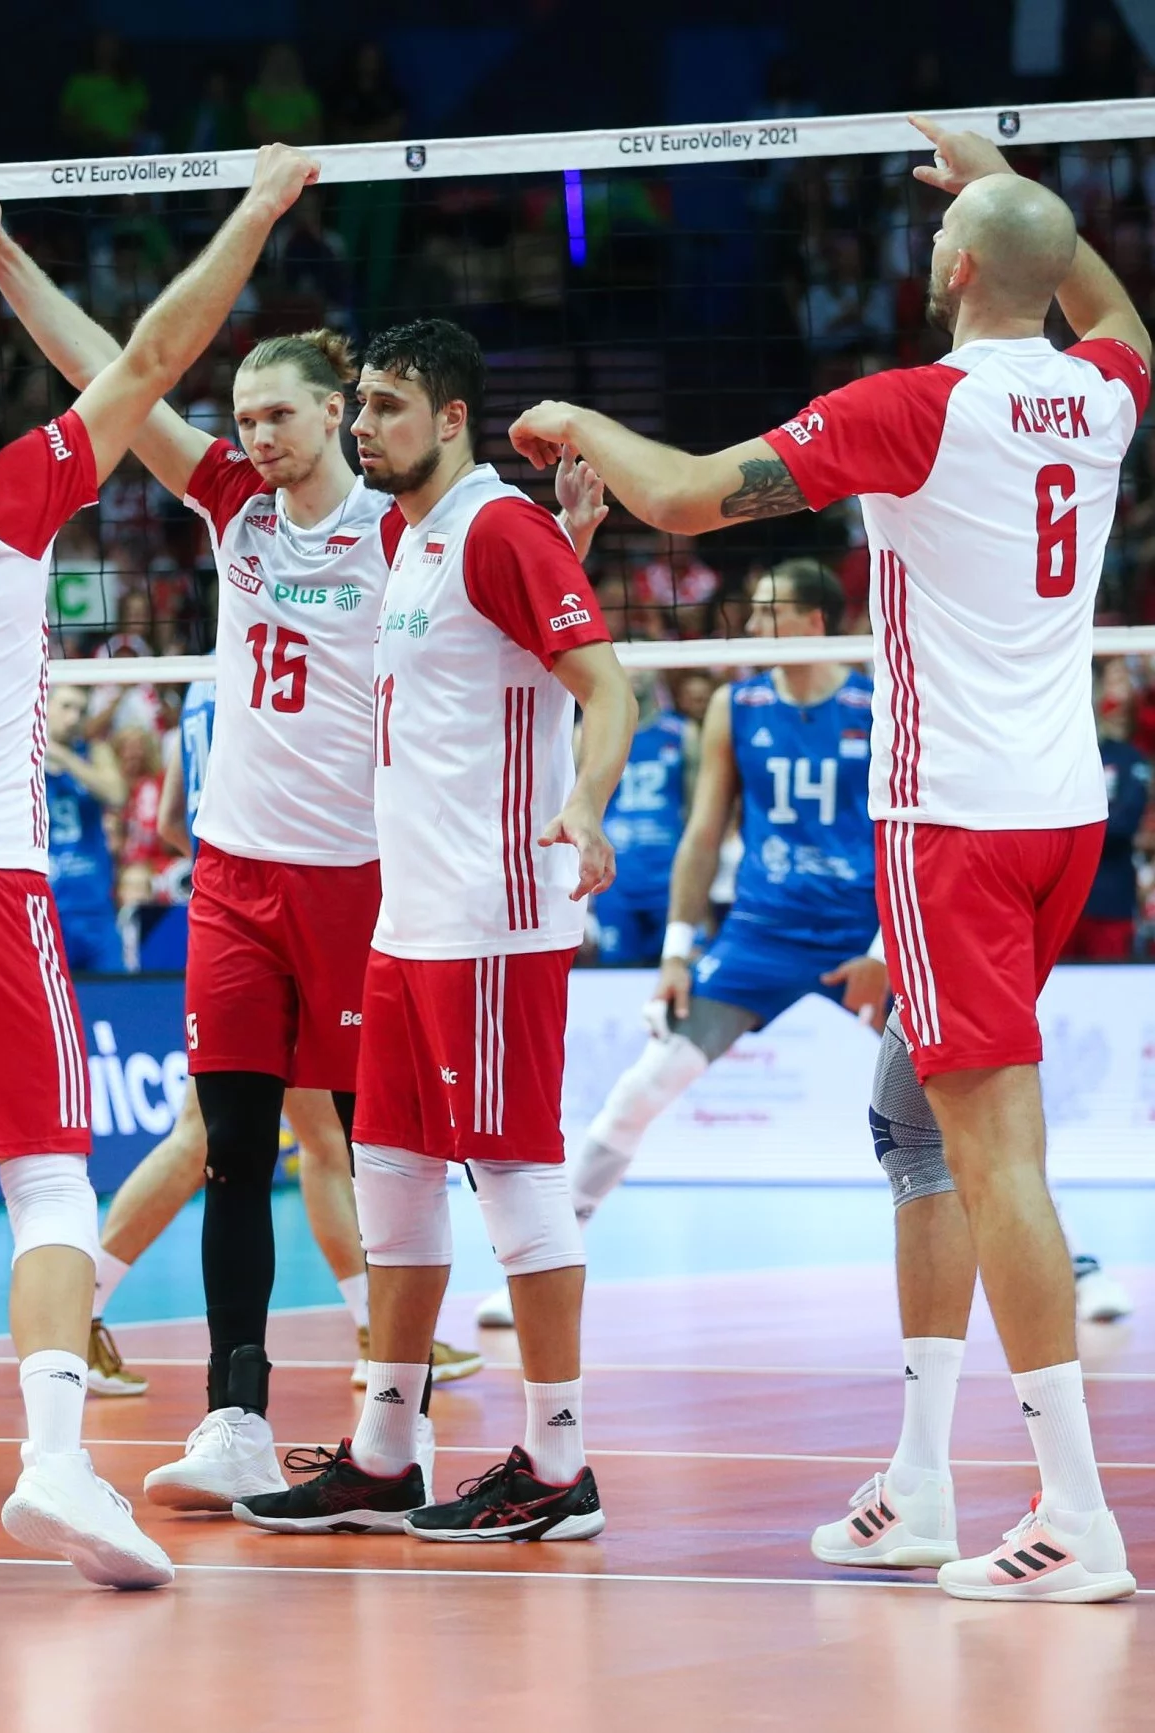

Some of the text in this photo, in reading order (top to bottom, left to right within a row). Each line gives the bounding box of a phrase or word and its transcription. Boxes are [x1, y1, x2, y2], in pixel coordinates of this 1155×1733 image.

[619, 128, 798, 154] CEV EuroVolley 2021
[51, 159, 219, 185] CEV EuroVolley 2021
[245, 515, 277, 537] adidas
[1034, 462, 1078, 599] 6
[275, 583, 328, 604] plus
[552, 609, 590, 631] ORLEN
[246, 622, 309, 714] 15
[619, 759, 668, 813] 12
[765, 756, 838, 826] 14
[374, 1395, 405, 1405] adidas
[547, 1419, 577, 1427] adidas
